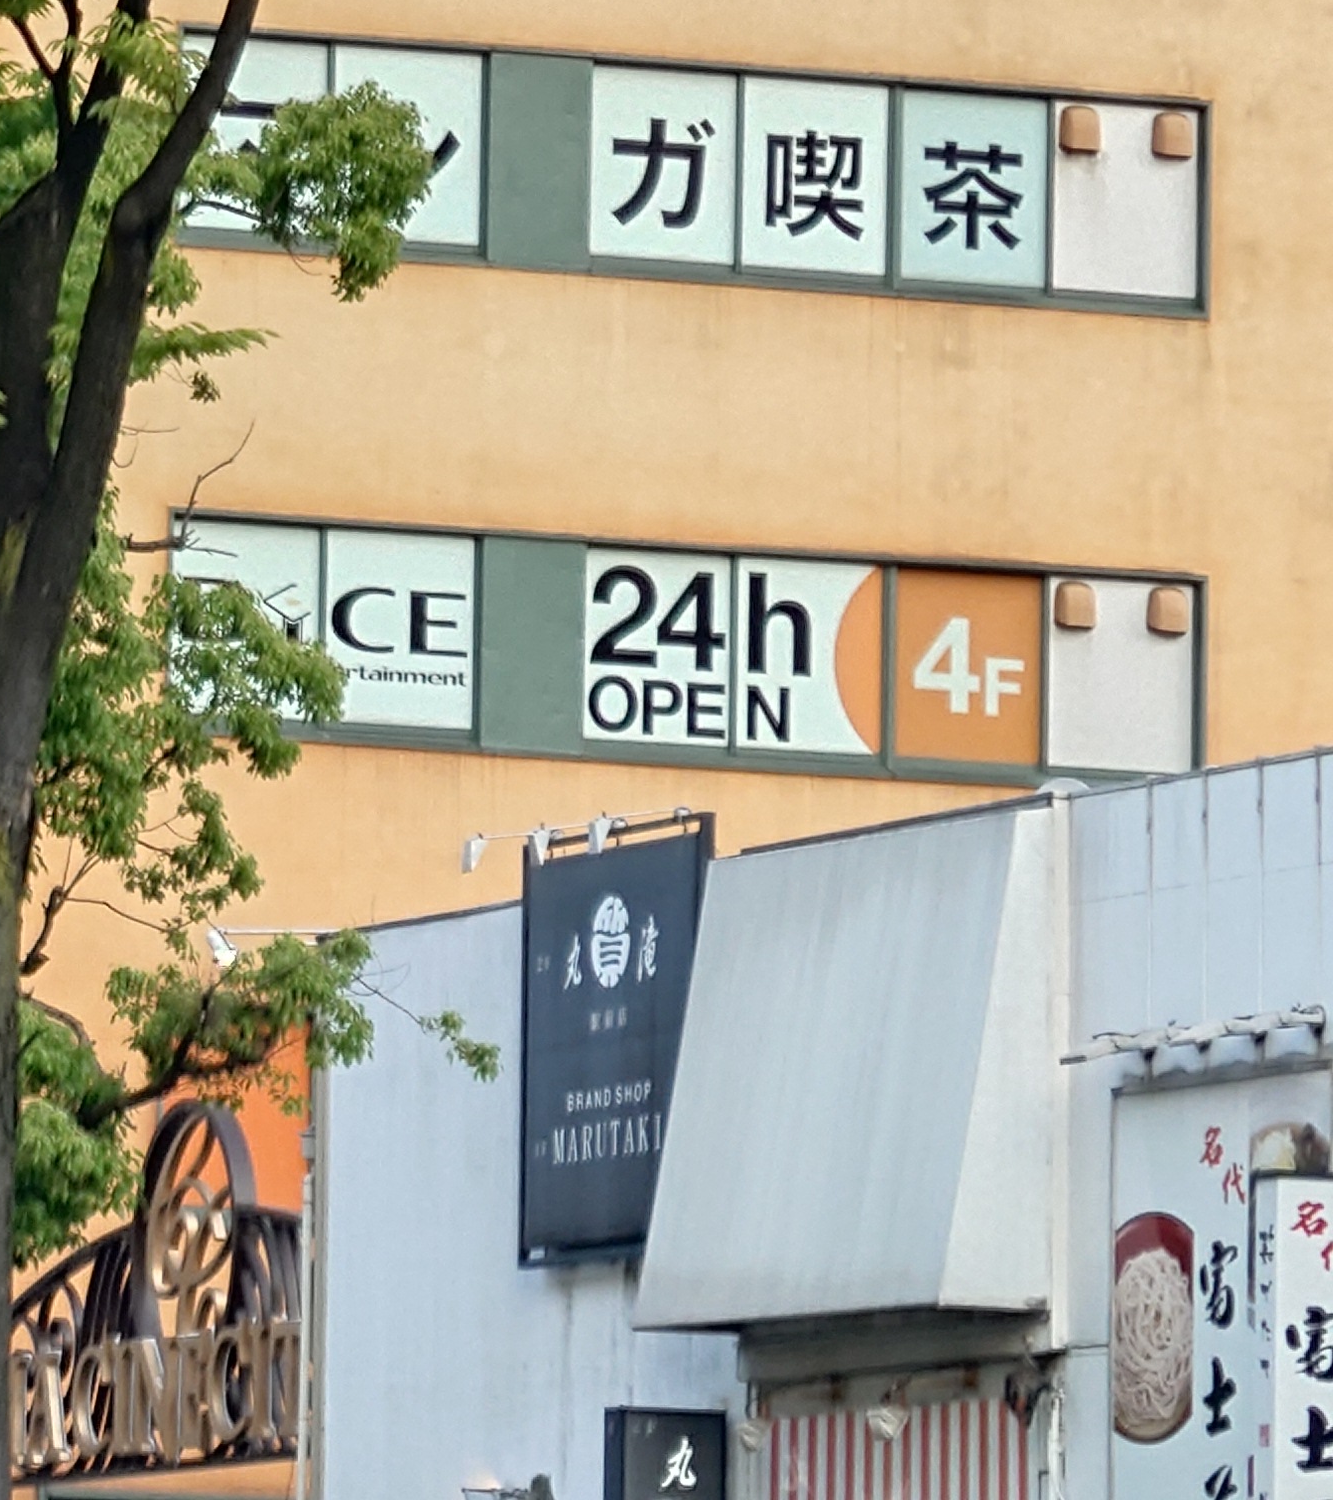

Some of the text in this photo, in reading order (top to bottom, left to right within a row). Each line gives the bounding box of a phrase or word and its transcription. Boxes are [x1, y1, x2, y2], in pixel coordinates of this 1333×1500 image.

[590, 565, 813, 676] 24h
[912, 618, 1026, 717] 4F
[587, 675, 791, 743] OPEN
[566, 1078, 653, 1113] BRAND SHOP
[552, 1114, 662, 1165] MARUTAKI
